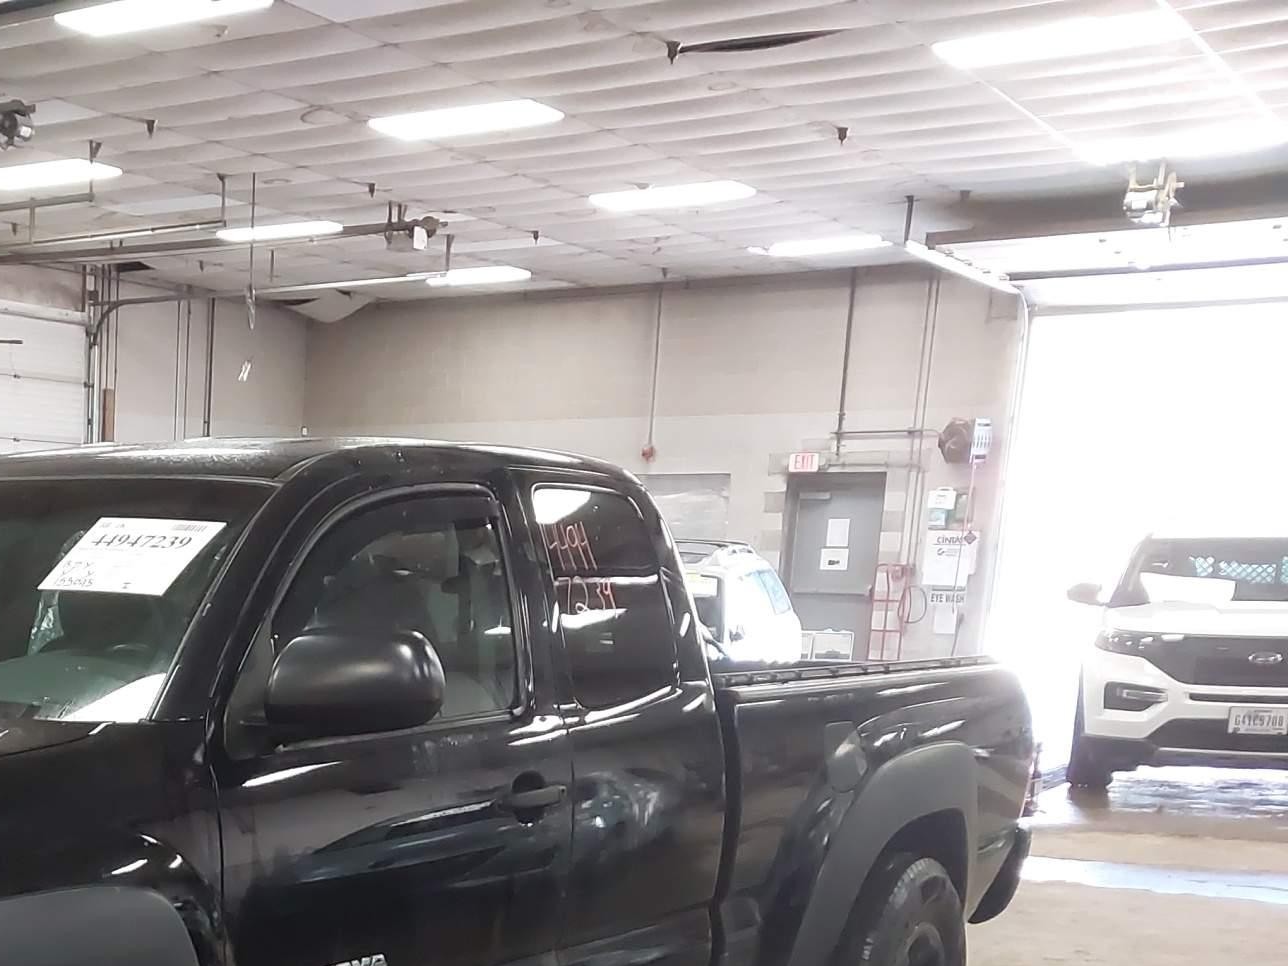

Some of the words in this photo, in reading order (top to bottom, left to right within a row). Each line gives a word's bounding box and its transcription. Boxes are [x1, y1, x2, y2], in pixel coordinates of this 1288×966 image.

[793, 454, 815, 470] EXIT
[91, 533, 193, 549] 44947239
[930, 593, 944, 604] EYE
